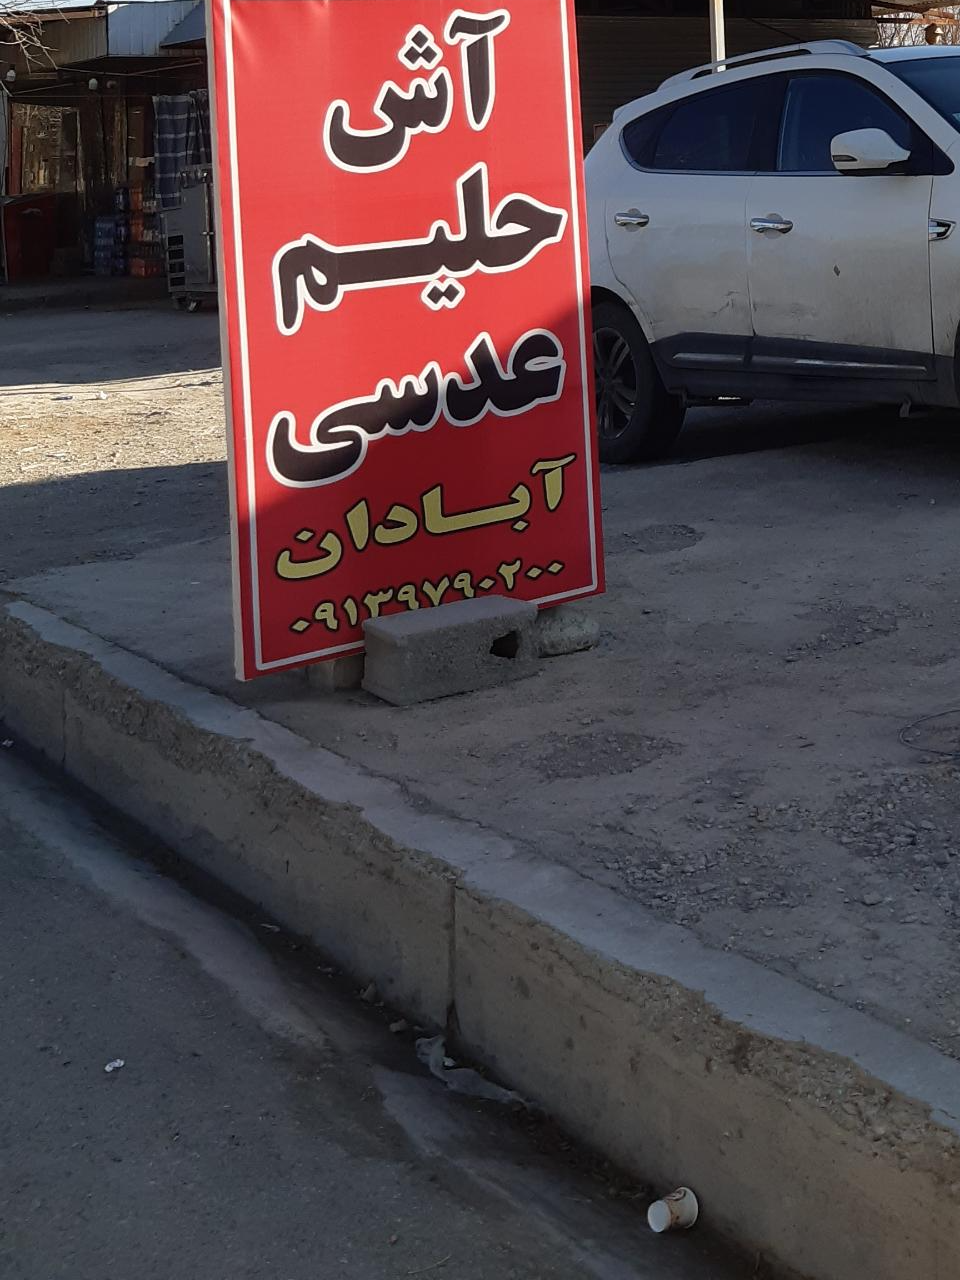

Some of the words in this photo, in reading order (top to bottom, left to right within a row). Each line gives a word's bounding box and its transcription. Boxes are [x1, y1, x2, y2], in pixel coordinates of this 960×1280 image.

[323, 9, 510, 173] آش
[273, 161, 568, 334] حلیم
[265, 328, 567, 488] عدسی
[275, 453, 576, 580] آبادان
[289, 559, 565, 633] ۰۹۱۳۹۷۹۰۲۰۰
